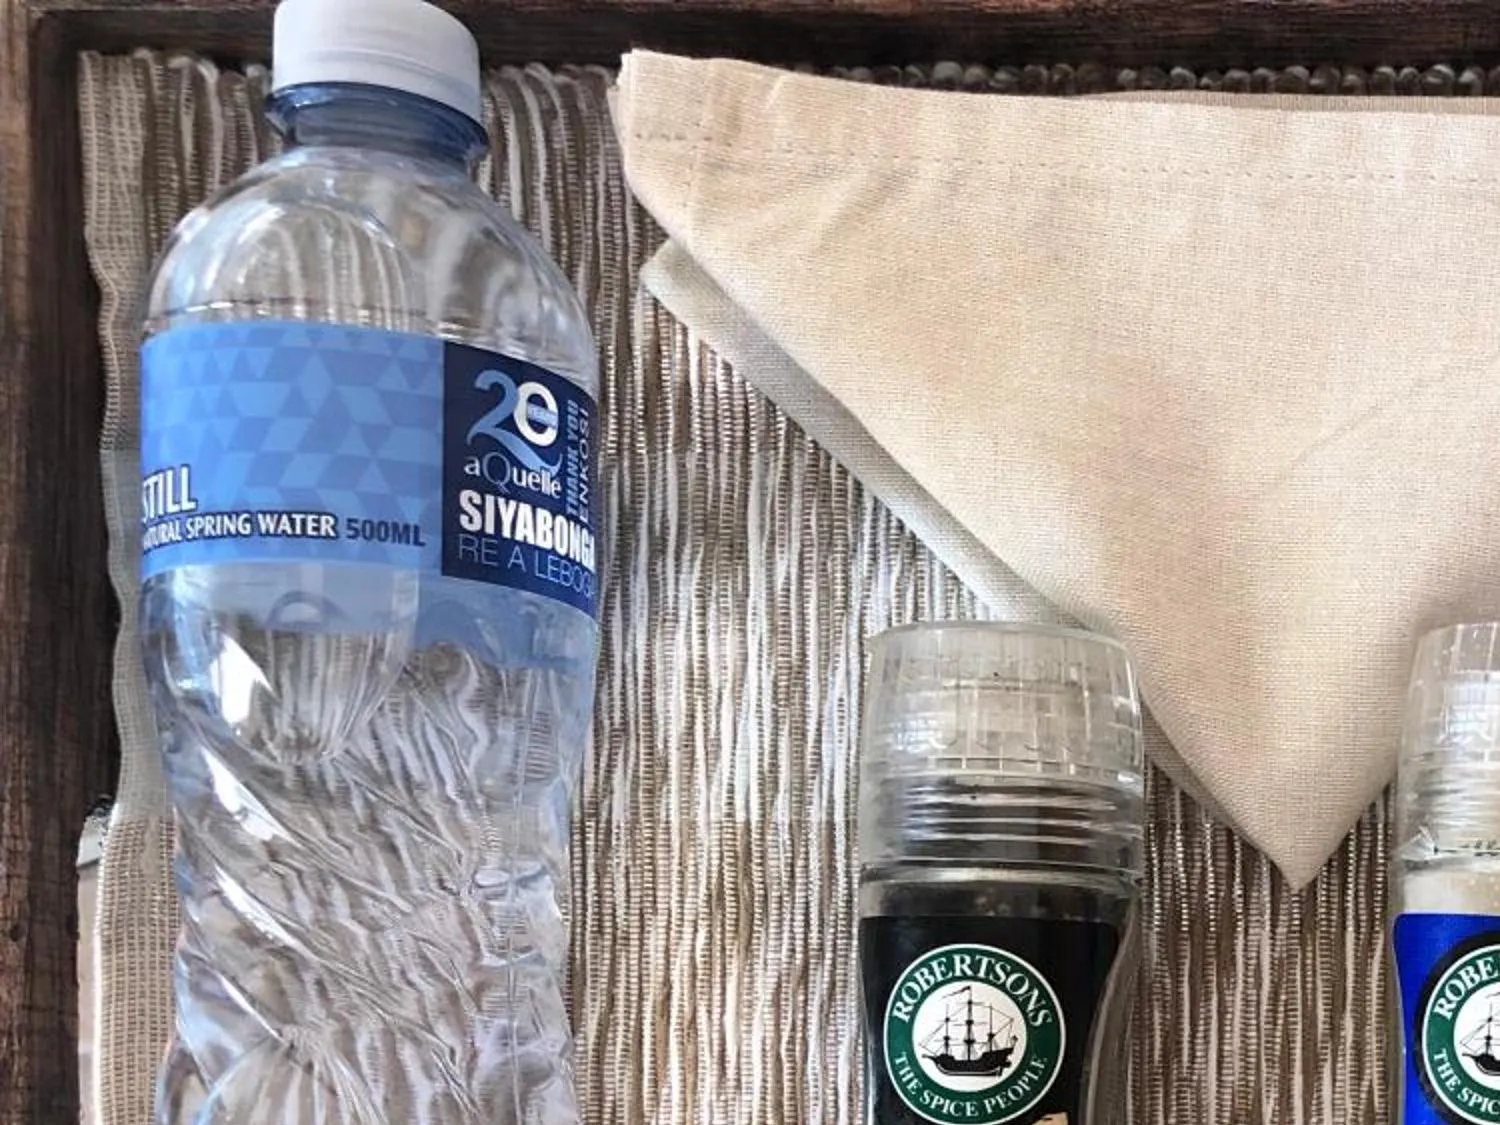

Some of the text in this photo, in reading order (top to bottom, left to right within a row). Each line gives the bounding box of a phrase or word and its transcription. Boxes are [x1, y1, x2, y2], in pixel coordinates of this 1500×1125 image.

[464, 453, 562, 499] aQuelle
[566, 399, 580, 517] THANK YOU
[142, 465, 197, 523] STILL
[186, 512, 251, 539] SPRING
[257, 512, 337, 537] WATER
[345, 519, 427, 547] 500ML
[458, 534, 596, 599] RE A LEBOG
[891, 953, 1053, 1028] ROBERTSONS
[895, 1052, 1048, 1118] THE SPICE PEOPLE
[1432, 1047, 1458, 1093] THE
